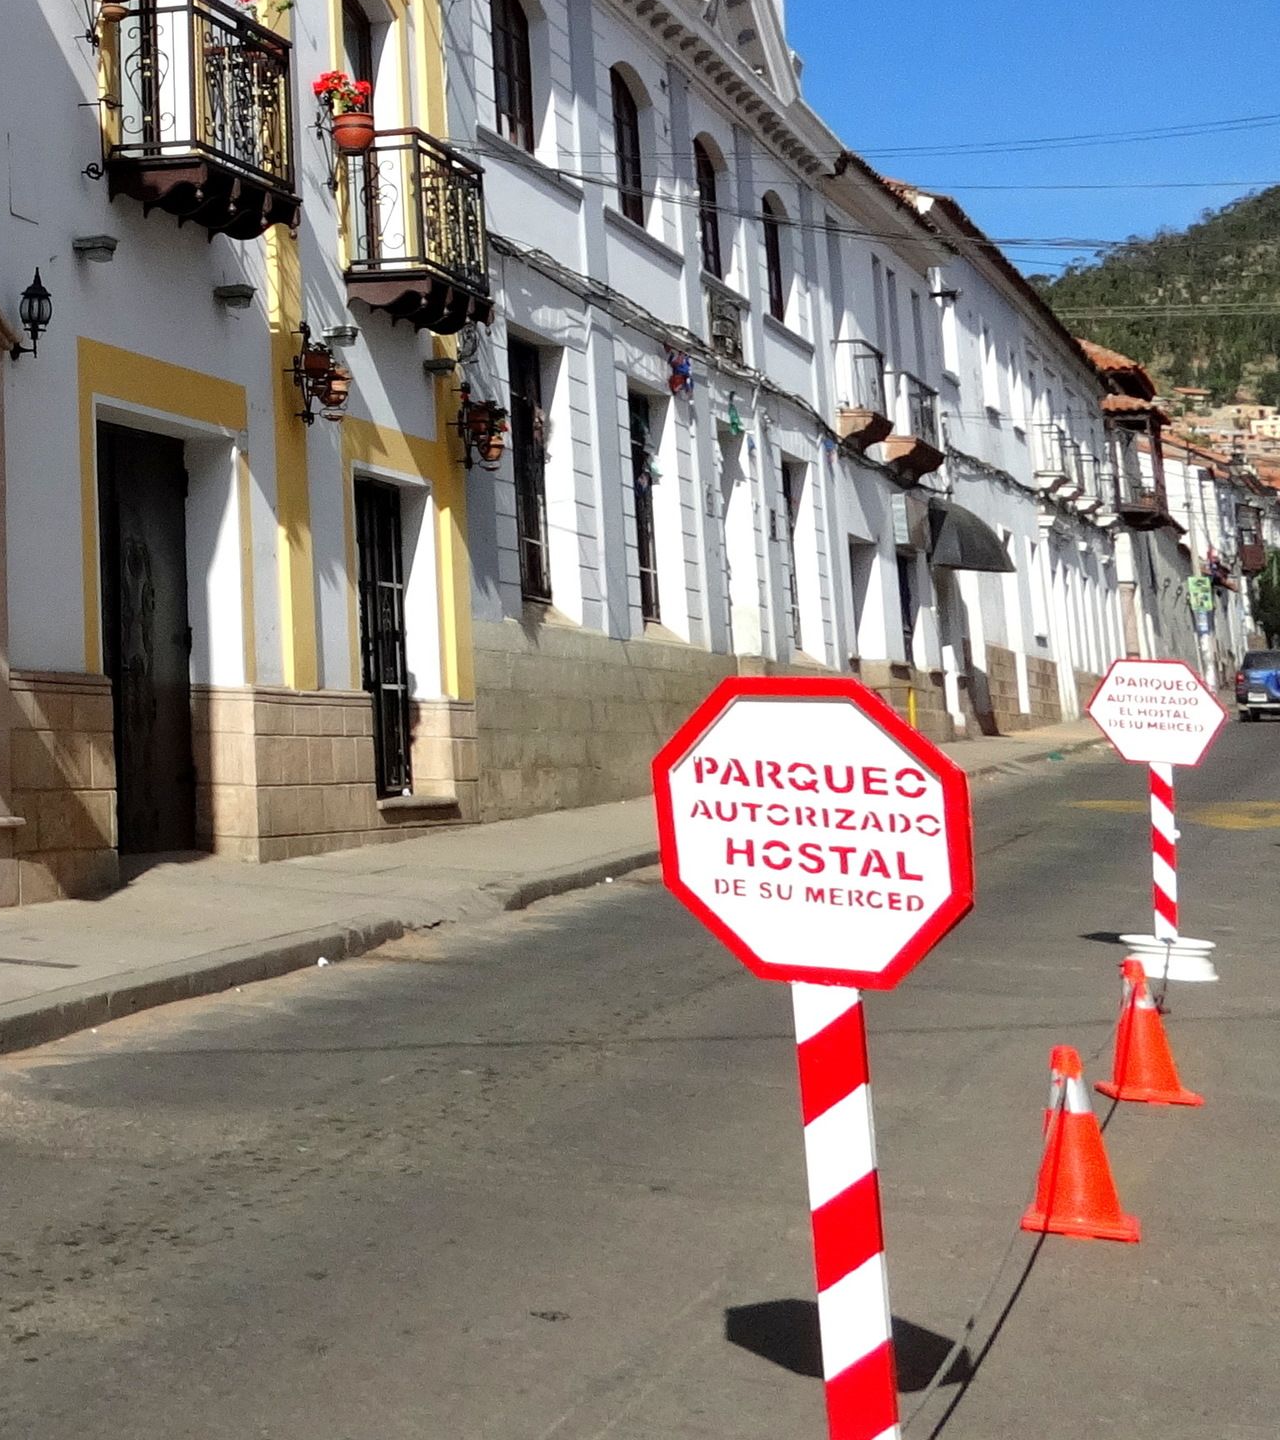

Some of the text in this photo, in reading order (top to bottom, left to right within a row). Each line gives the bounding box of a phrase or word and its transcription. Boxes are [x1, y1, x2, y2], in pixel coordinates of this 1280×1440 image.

[1115, 676, 1198, 691] PARQUEO
[1107, 694, 1199, 706] AUTORIZADO
[1138, 707, 1190, 719] HOSTAL
[1147, 720, 1204, 732] MERCED
[693, 756, 927, 799] PARQUEO
[690, 800, 941, 837] AUTORIZADO
[725, 838, 924, 882] HOSTAL
[714, 879, 924, 912] DE SU MERCED
